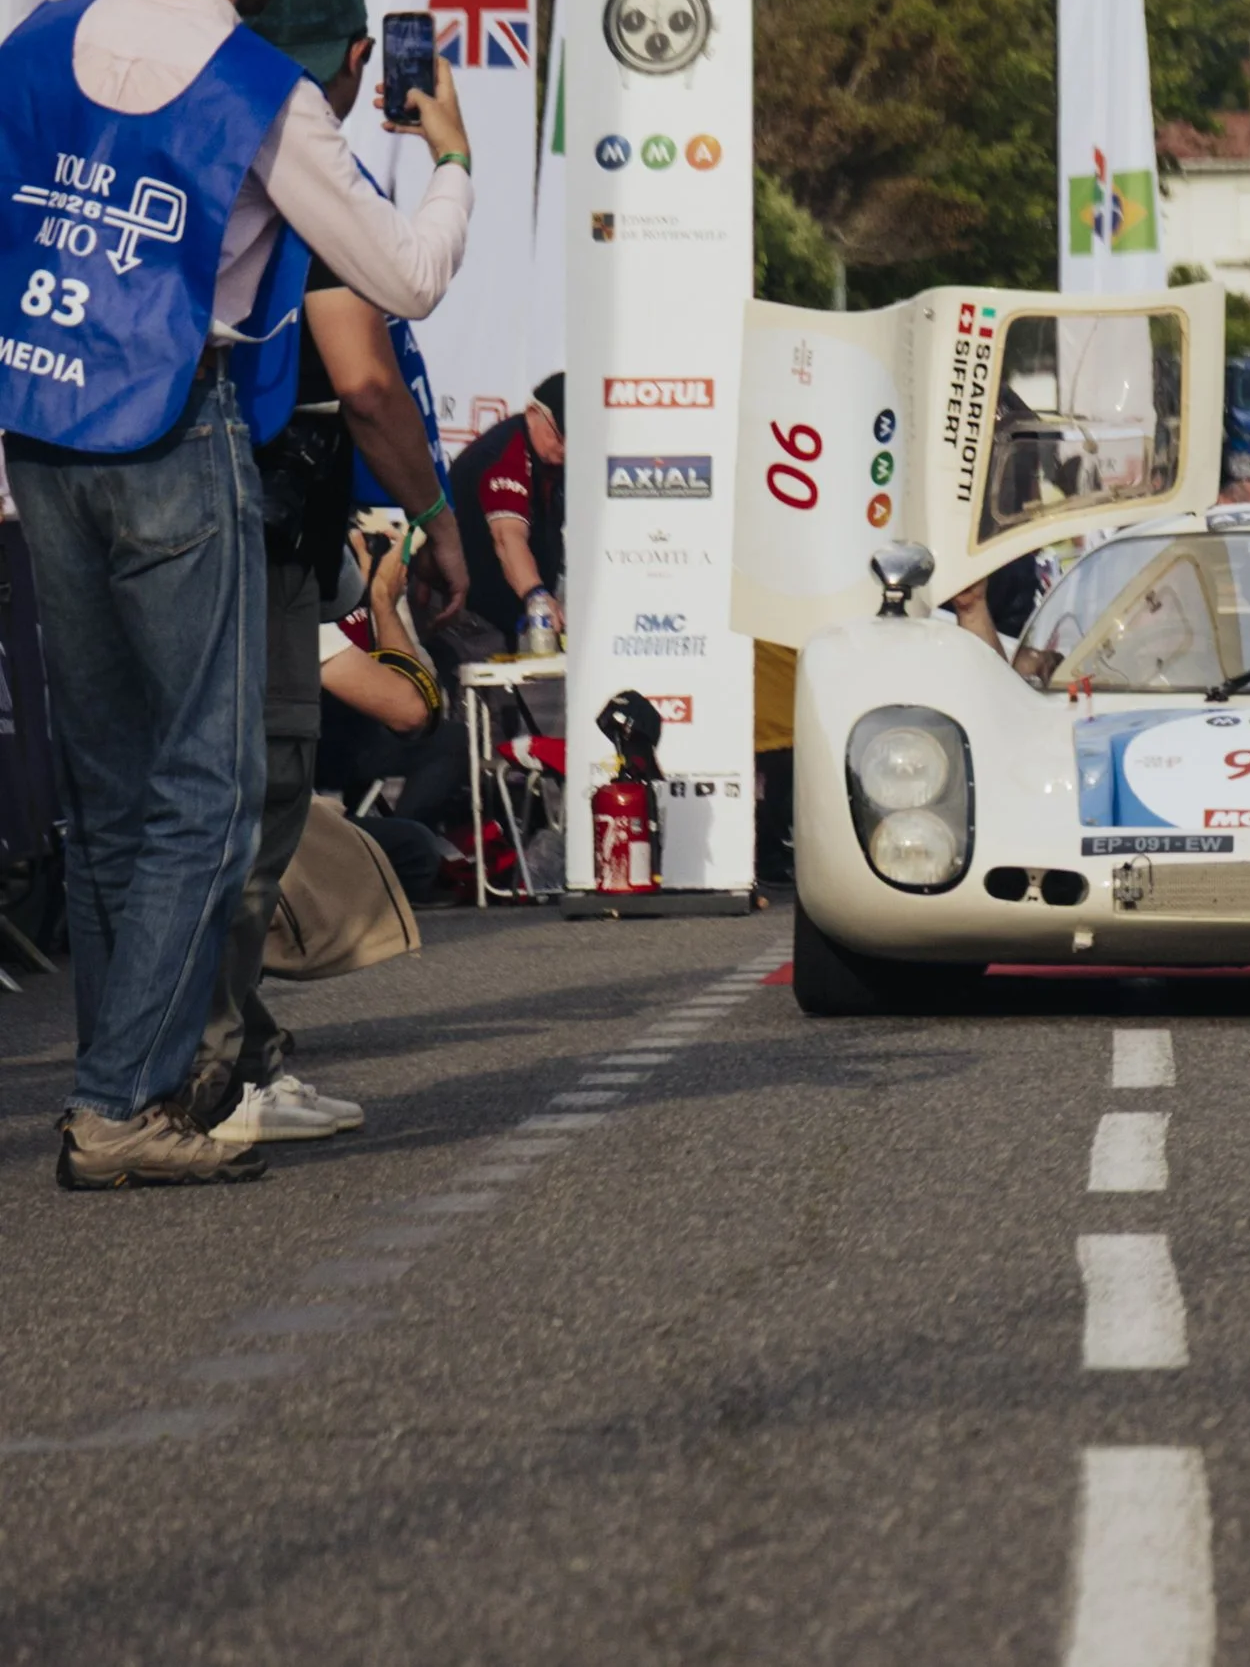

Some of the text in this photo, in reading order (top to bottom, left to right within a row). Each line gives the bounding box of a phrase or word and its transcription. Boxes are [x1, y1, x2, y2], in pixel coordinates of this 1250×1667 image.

[54, 153, 116, 197] TOUR
[48, 191, 102, 219] 2026
[34, 217, 97, 257] AUTO
[20, 269, 90, 328] 83
[608, 380, 711, 406] MOTUL
[943, 339, 970, 449] SIFFERT
[957, 343, 991, 502] SCARFIOTTI
[610, 466, 710, 490] AXIAL
[767, 420, 823, 510] 90
